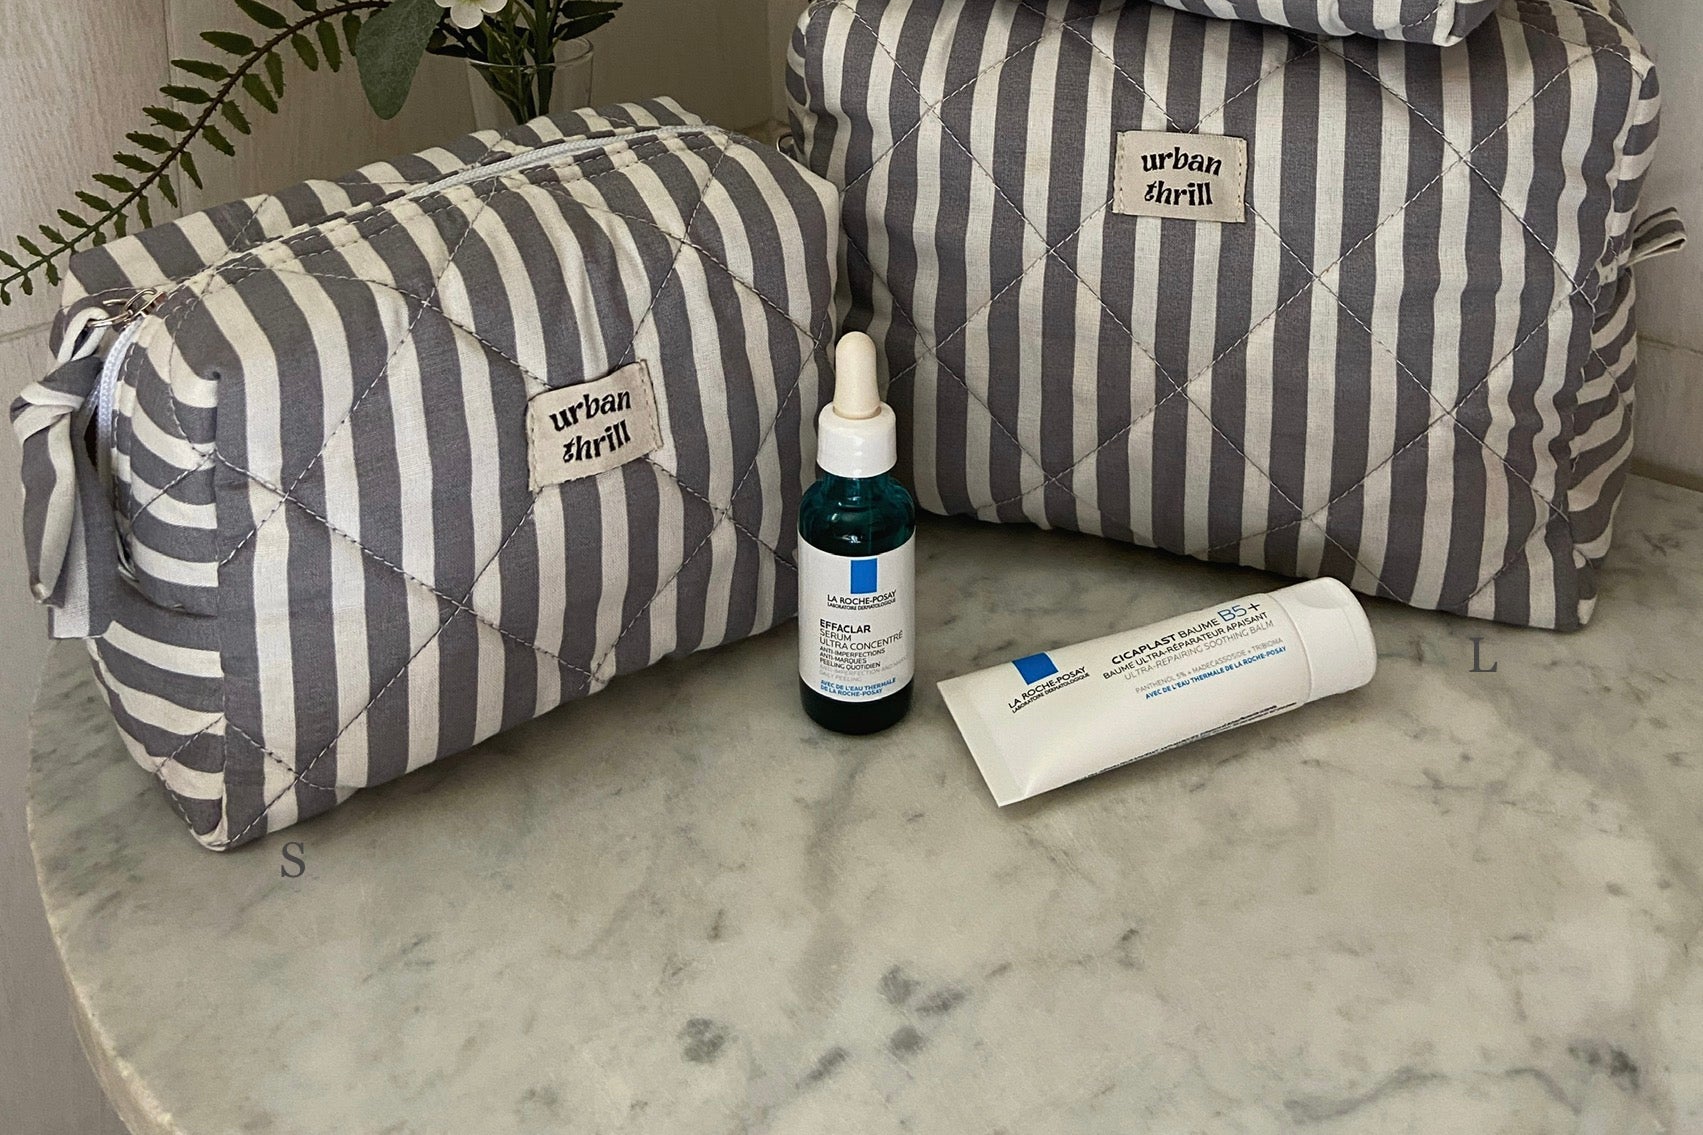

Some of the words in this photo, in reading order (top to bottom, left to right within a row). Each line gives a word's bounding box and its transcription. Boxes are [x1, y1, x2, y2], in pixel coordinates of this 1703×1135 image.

[1141, 147, 1222, 176] urban
[1145, 180, 1213, 206] thrill
[549, 391, 631, 432] urban
[563, 419, 631, 463] thrill
[827, 594, 838, 603] LA
[840, 589, 897, 605] ROCHE-POSAY
[820, 618, 871, 634] EFFACLAR
[820, 637, 848, 650] ULTRA
[1102, 661, 1135, 679] BAUME
[1226, 612, 1268, 632] APAISANT
[1112, 634, 1176, 664] CICAPLAST
[1178, 618, 1220, 638] BAUME
[1124, 645, 1203, 680] ULTRA-REPAIRING
[1204, 629, 1249, 650] SOOTHING
[1249, 620, 1274, 634] BALM
[820, 652, 867, 664] ANTI-MARQUES
[820, 657, 845, 669] PEELING
[846, 661, 881, 671] QUOTIDIEN
[1145, 689, 1162, 699] AVEC
[1162, 685, 1172, 693] DE
[1171, 679, 1191, 690] L'EAU
[1190, 666, 1225, 683] THERMALE
[1225, 663, 1234, 672] DE
[1234, 661, 1242, 669] LA
[1242, 646, 1286, 665] ROCHE-POSAY
[821, 679, 834, 688] AVEC
[1008, 698, 1021, 709] LA
[1021, 666, 1086, 700] ROCHE-POSAY
